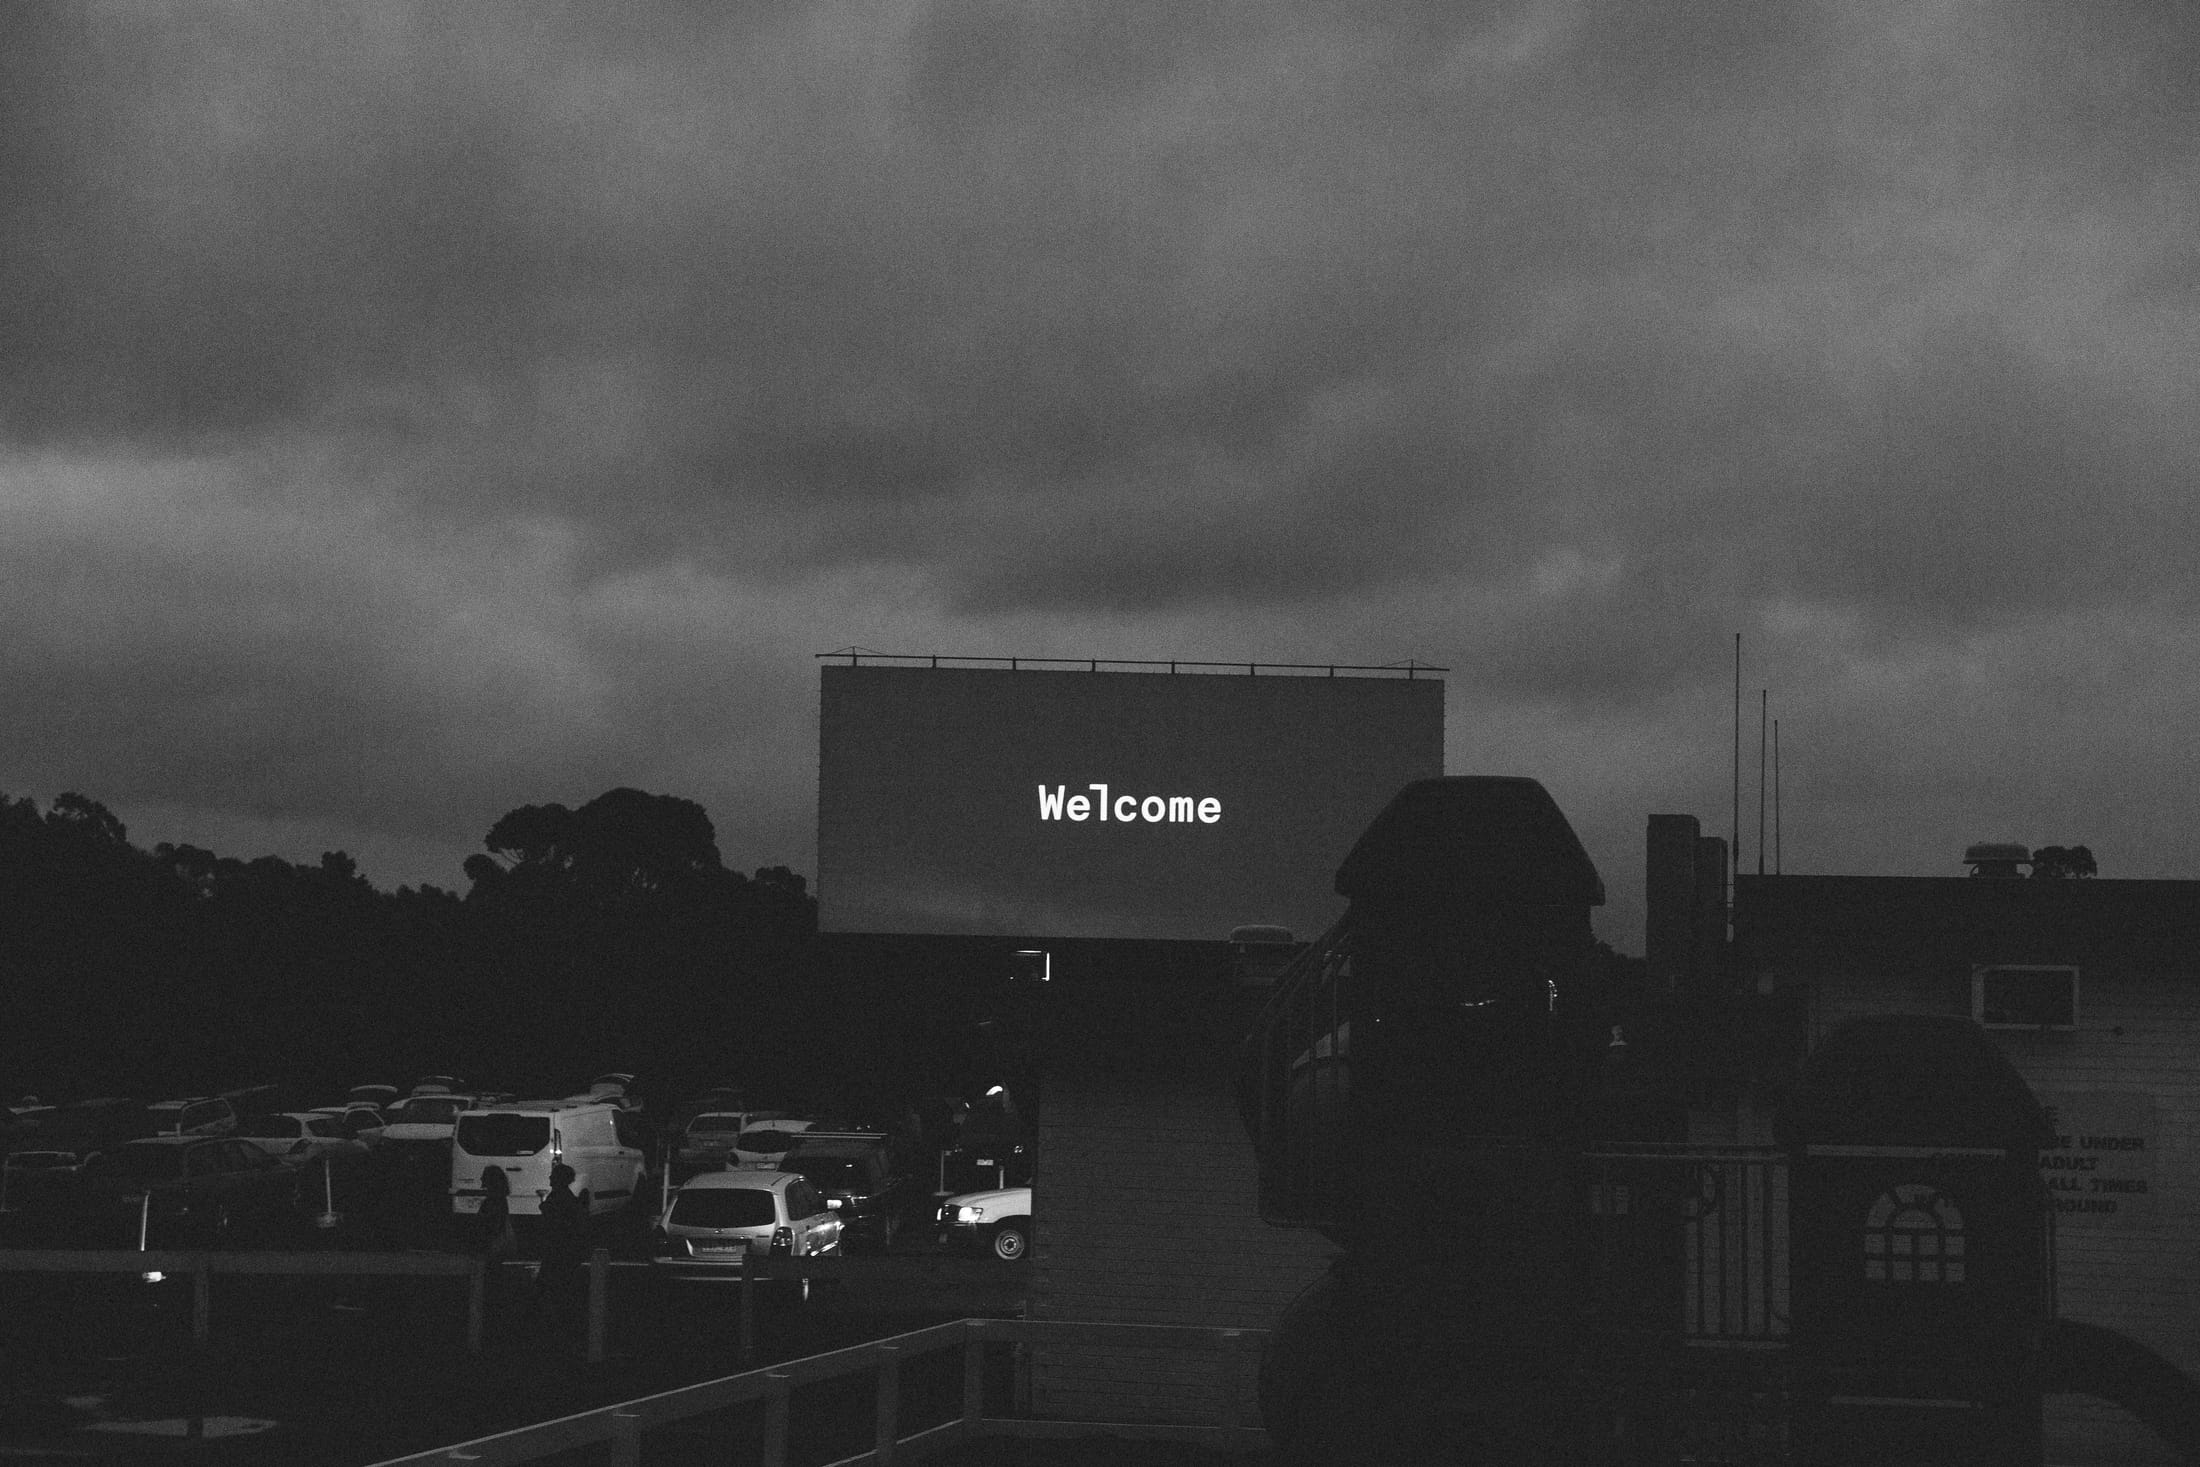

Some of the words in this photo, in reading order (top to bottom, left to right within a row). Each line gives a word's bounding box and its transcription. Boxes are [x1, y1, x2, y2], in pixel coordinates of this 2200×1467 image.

[1037, 783, 1222, 824] Welcome
[2079, 1135, 2145, 1151] UNDER
[2040, 1155, 2099, 1171] ADULT
[2048, 1176, 2082, 1192] ALL
[2089, 1177, 2148, 1194] TIMES
